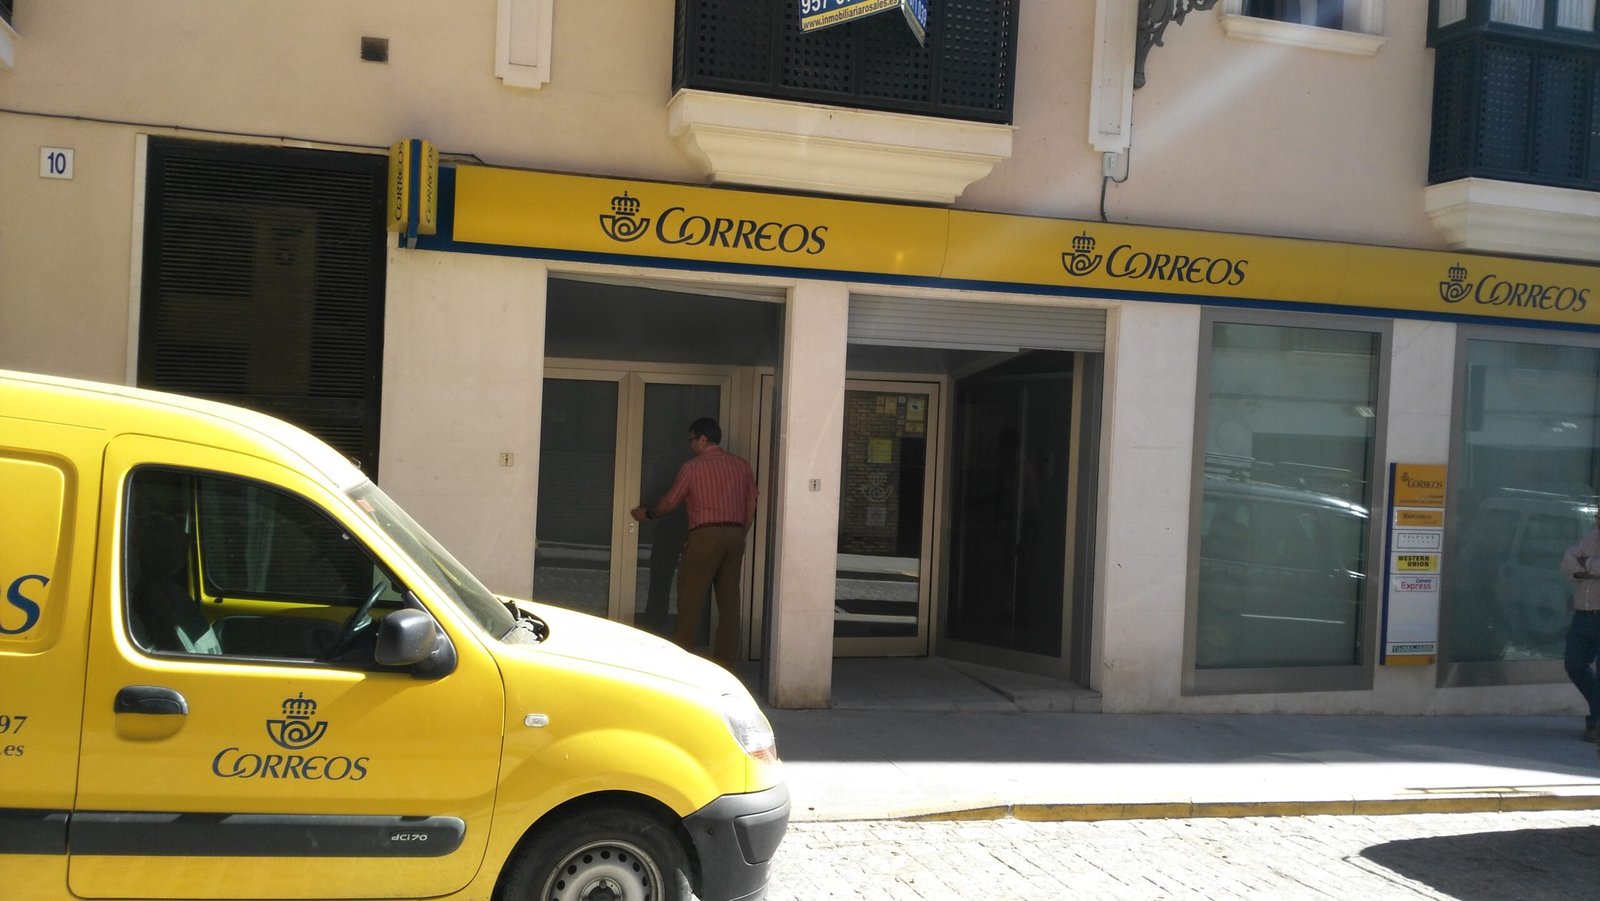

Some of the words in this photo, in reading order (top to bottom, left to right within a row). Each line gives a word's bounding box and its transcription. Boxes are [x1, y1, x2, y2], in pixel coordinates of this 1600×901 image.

[47, 151, 67, 175] 10
[655, 206, 829, 255] CORREOS
[1105, 244, 1249, 286] CORREOS
[1474, 274, 1591, 312] CORREOS
[1407, 479, 1444, 489] CORREOS
[1400, 581, 1432, 592] Express
[212, 747, 369, 781] CORREOS
